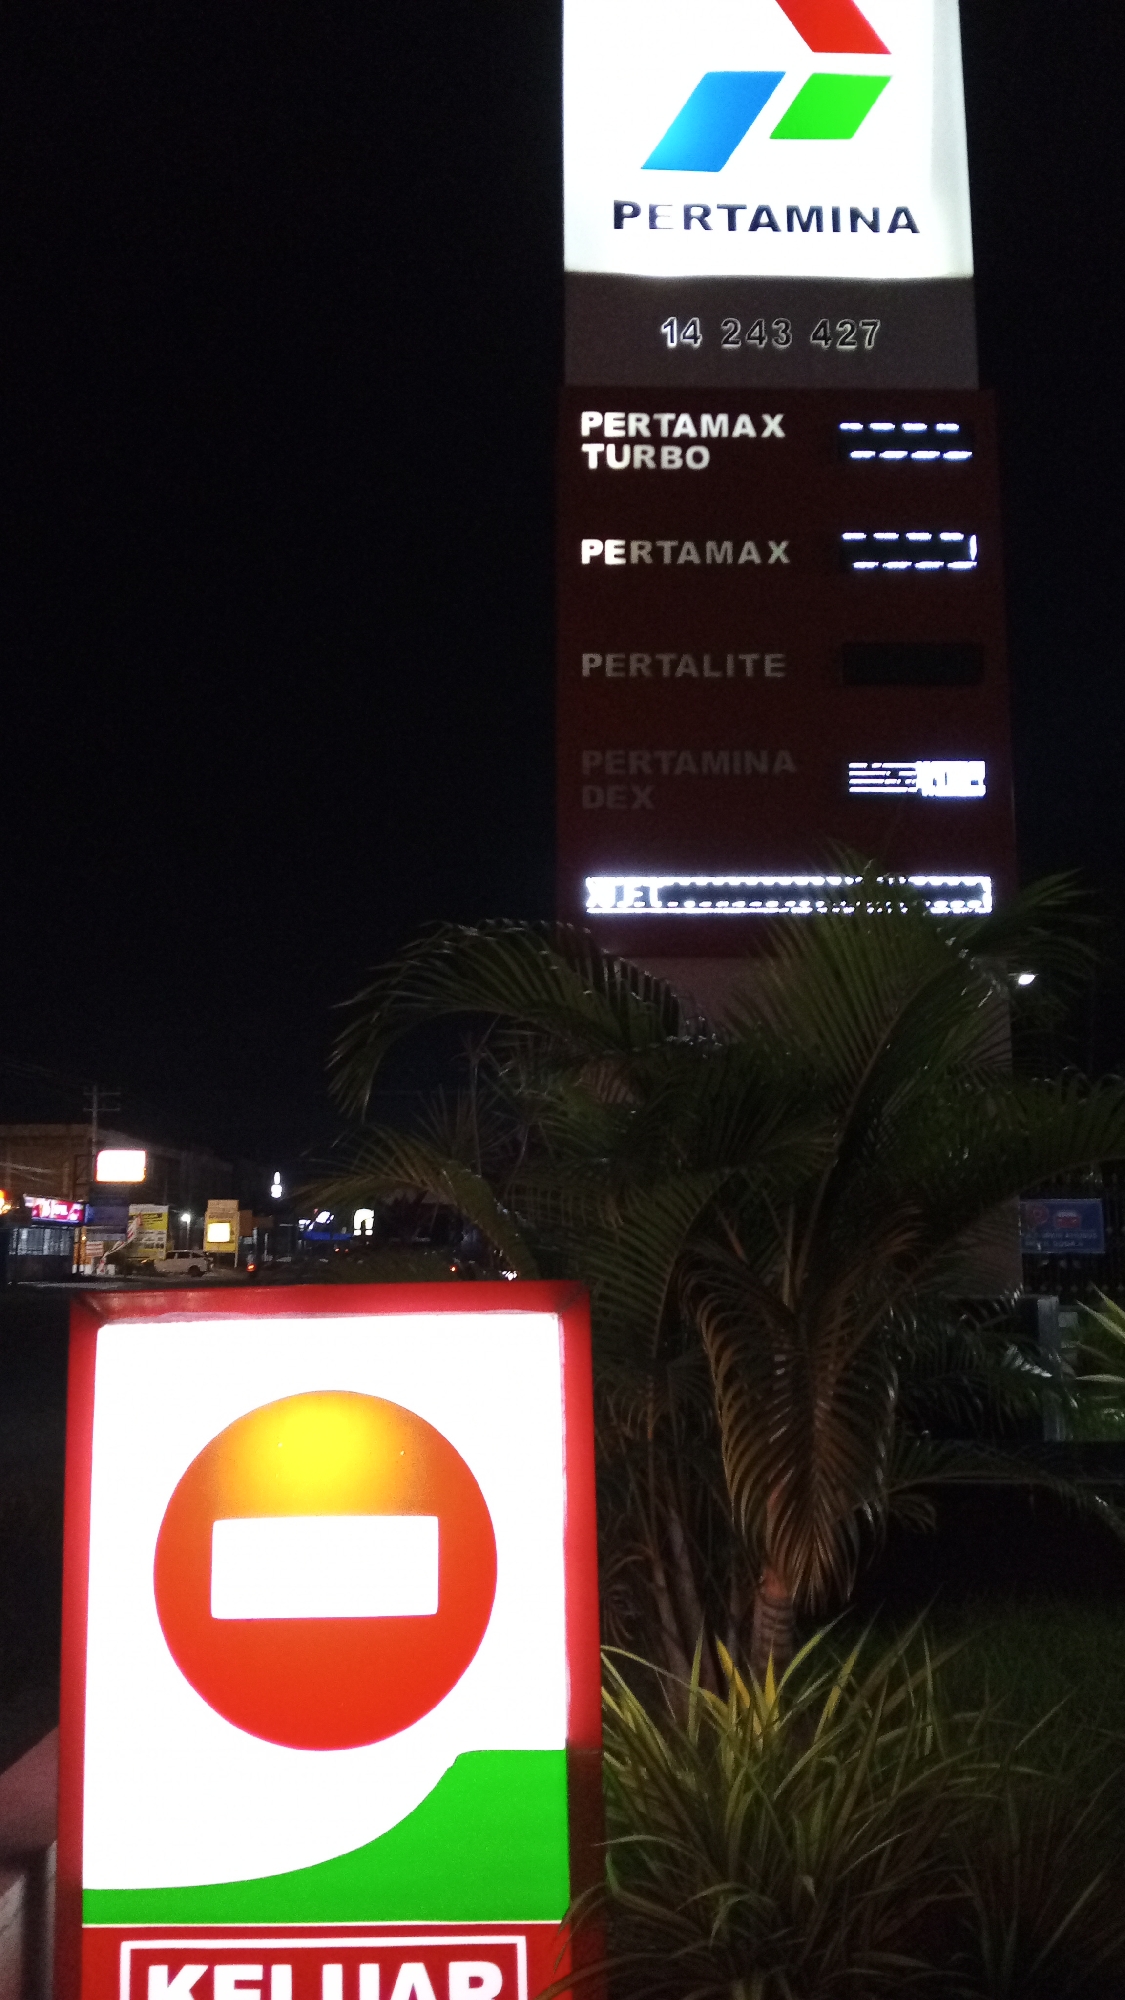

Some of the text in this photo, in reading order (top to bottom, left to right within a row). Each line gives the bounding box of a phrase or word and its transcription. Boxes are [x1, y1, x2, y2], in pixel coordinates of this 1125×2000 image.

[612, 200, 920, 234] PERTAMINA
[659, 316, 882, 352] 14 243 427
[580, 411, 786, 438] PERTAMAX
[580, 443, 710, 470] TURBO
[580, 538, 790, 566] PERTAMAX
[581, 652, 786, 678] PERTALITE
[581, 749, 798, 776] PERTAMINA
[581, 784, 655, 811] DEX
